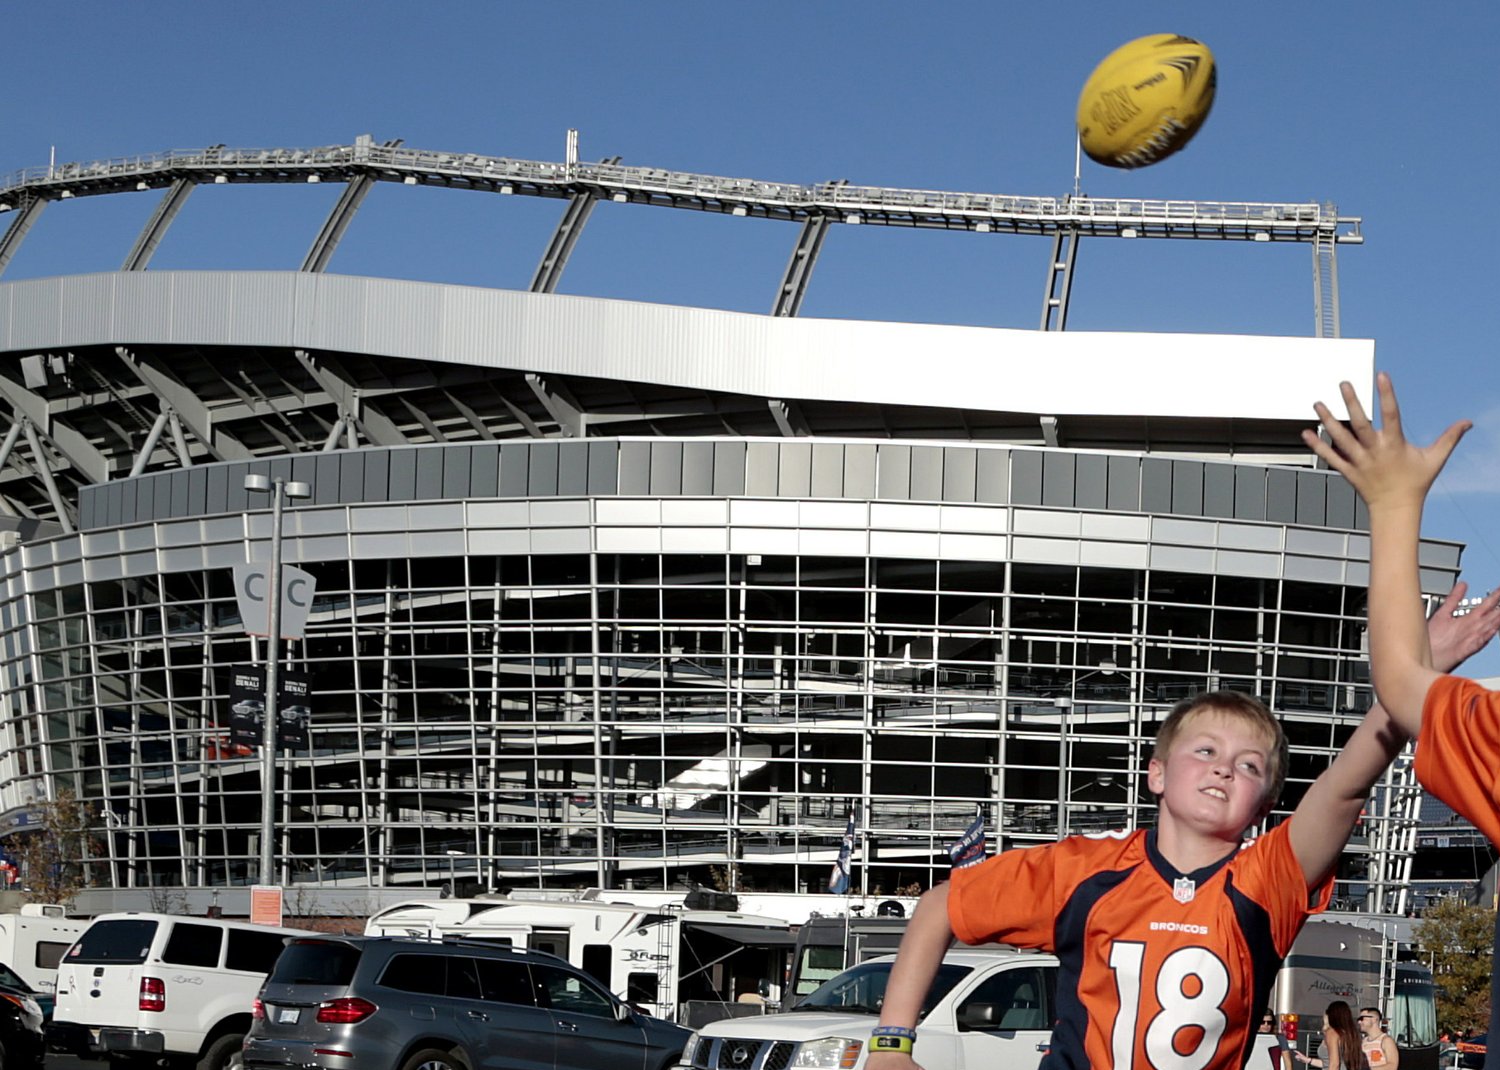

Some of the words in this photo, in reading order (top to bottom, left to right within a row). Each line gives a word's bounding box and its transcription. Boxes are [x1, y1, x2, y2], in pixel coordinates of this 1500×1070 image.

[244, 573, 265, 601] C
[287, 579, 306, 607] C
[1149, 921, 1209, 935] BRONCOS
